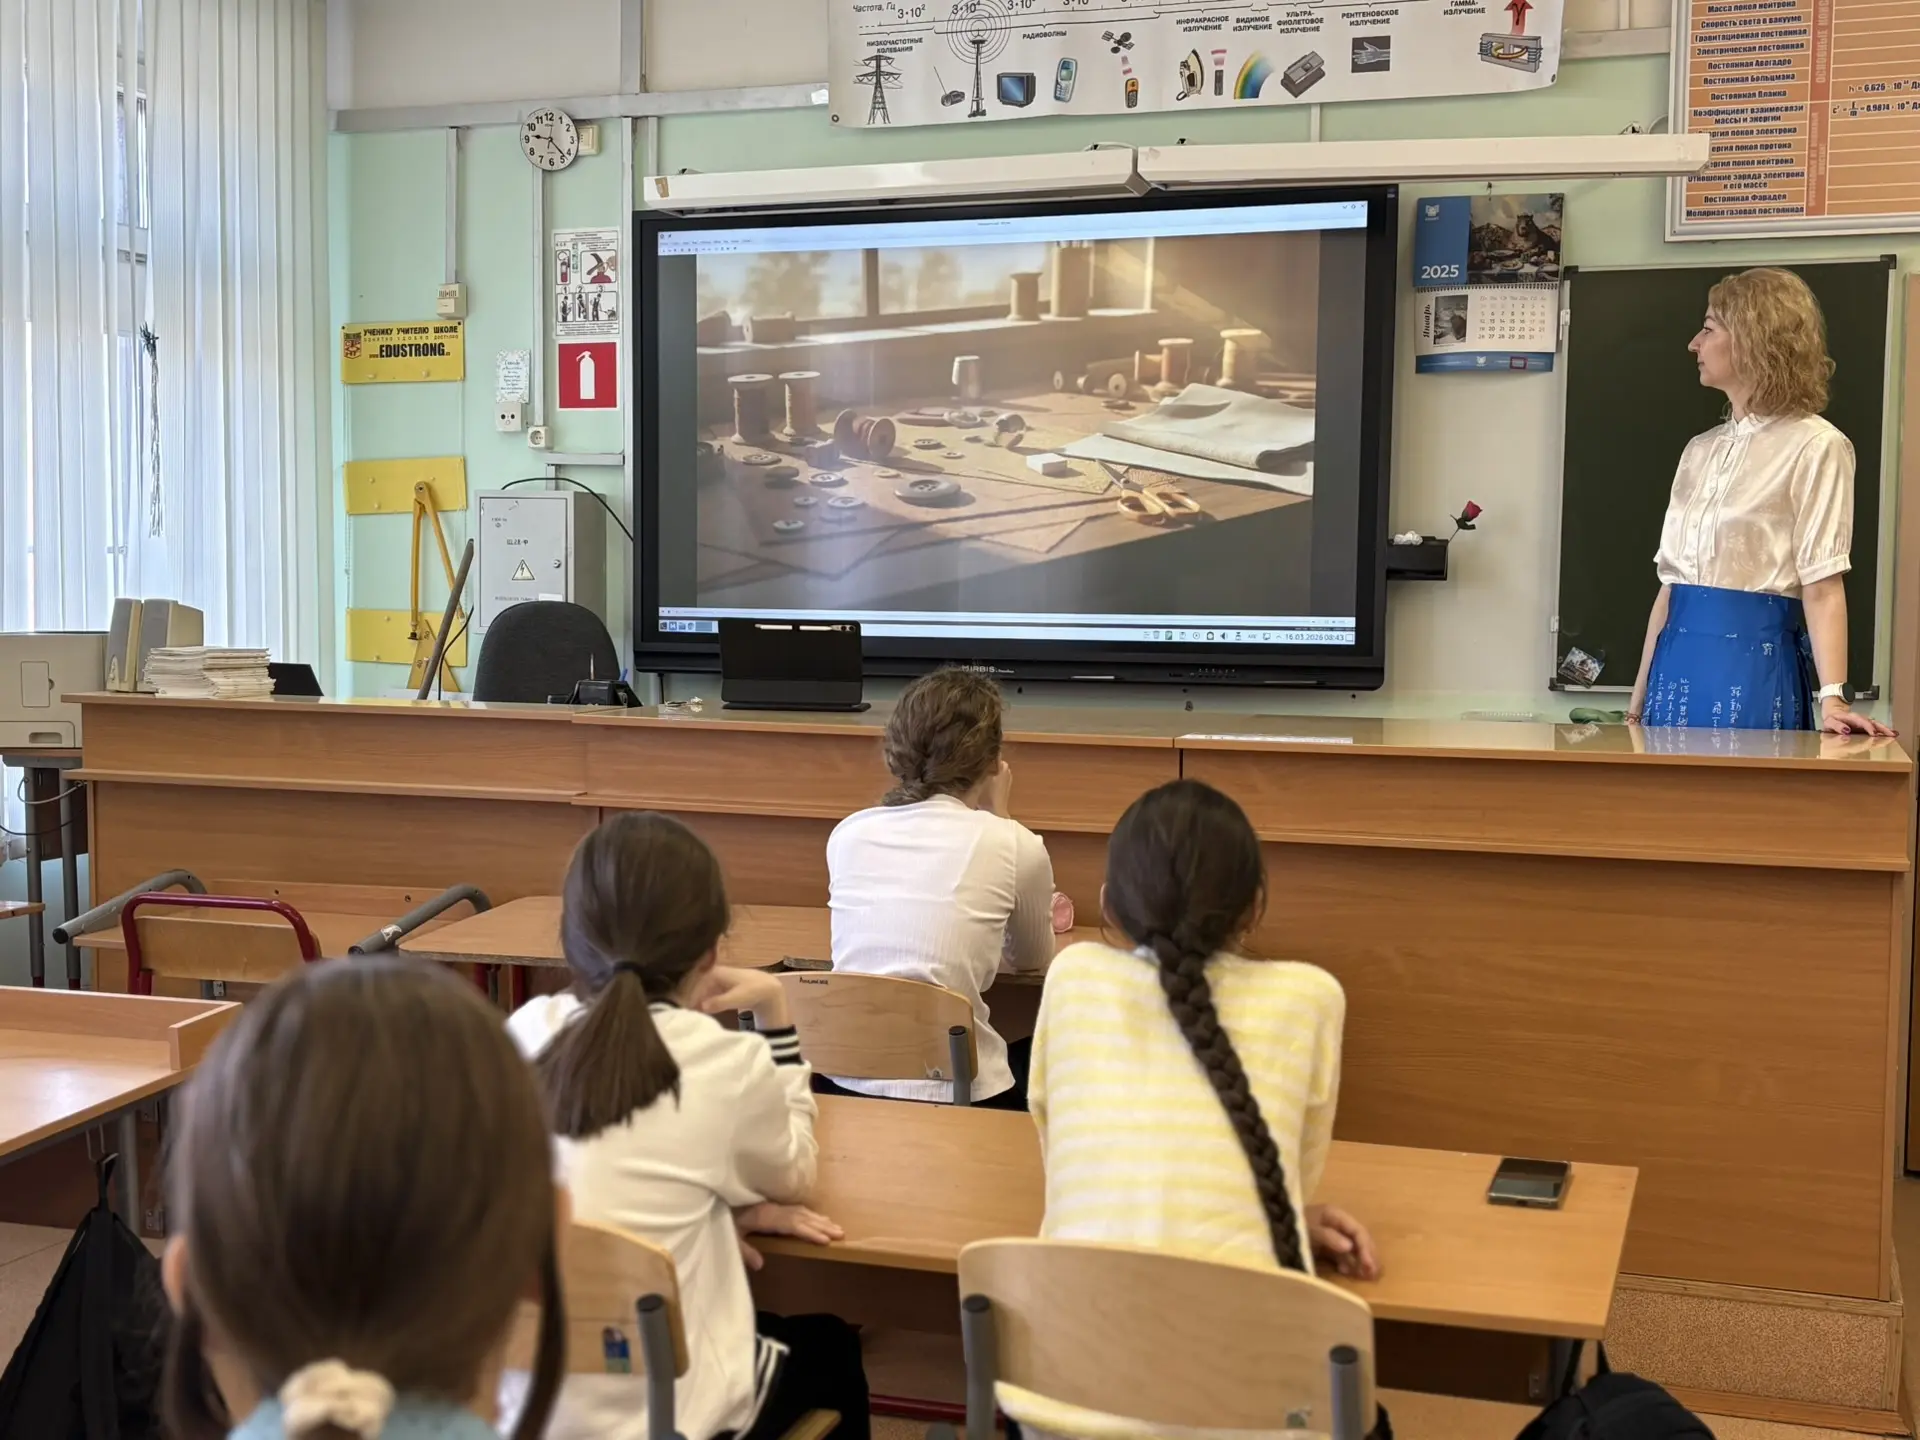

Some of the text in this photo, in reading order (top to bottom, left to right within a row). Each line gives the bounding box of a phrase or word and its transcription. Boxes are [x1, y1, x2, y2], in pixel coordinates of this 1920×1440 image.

[853, 2, 896, 12] Частота, Гц
[1342, 9, 1399, 19] РЕНТГЕНОВСКОЕ
[1176, 16, 1230, 25] ИНФРАКРАСНОЕ
[1236, 16, 1270, 24] ВИДИМОЕ
[1276, 18, 1324, 26] ФИОЛЕТОВОЕ
[1349, 18, 1391, 26] ИЗЛУЧЕНИЕ
[1701, 20, 1737, 29] Скорость
[1768, 15, 1802, 24] вакууме
[1183, 24, 1222, 33] ИЗЛУЧЕНИЕ
[1232, 24, 1272, 32] ИЗЛУЧЕНИЕ
[1280, 26, 1320, 34] ИЗЛУЧЕНИЕ
[1022, 30, 1068, 40] РАДИОВОЛНЫ
[1695, 28, 1807, 42] Гравитационная постоянная
[866, 37, 924, 47] НИЗКОЧАСТОТНЫЕ
[1697, 42, 1804, 56] Электрическая постоянная
[1708, 59, 1792, 70] Постоянная Авогадро
[1704, 73, 1796, 85] Постоянная Больцмана
[1711, 90, 1787, 100] Постоянная Планка
[1693, 105, 1804, 117] Коэффициент взаимосвязи
[536, 116, 543, 124] 11
[544, 112, 554, 121] 12
[559, 116, 563, 124] 1
[1749, 115, 1781, 123] энергии
[527, 123, 536, 131] 10
[1756, 127, 1797, 135] электрона
[524, 135, 530, 143] 9
[570, 136, 574, 144] 3
[529, 148, 535, 156] 8
[539, 155, 544, 163] 7
[549, 158, 555, 166] 6
[560, 155, 565, 164] 5
[1704, 195, 1749, 203] Постоянная
[1758, 207, 1804, 215] постоянная
[1422, 264, 1459, 279] 2025
[1423, 304, 1431, 338] Январь
[364, 328, 393, 336] УЧЕНИКУ
